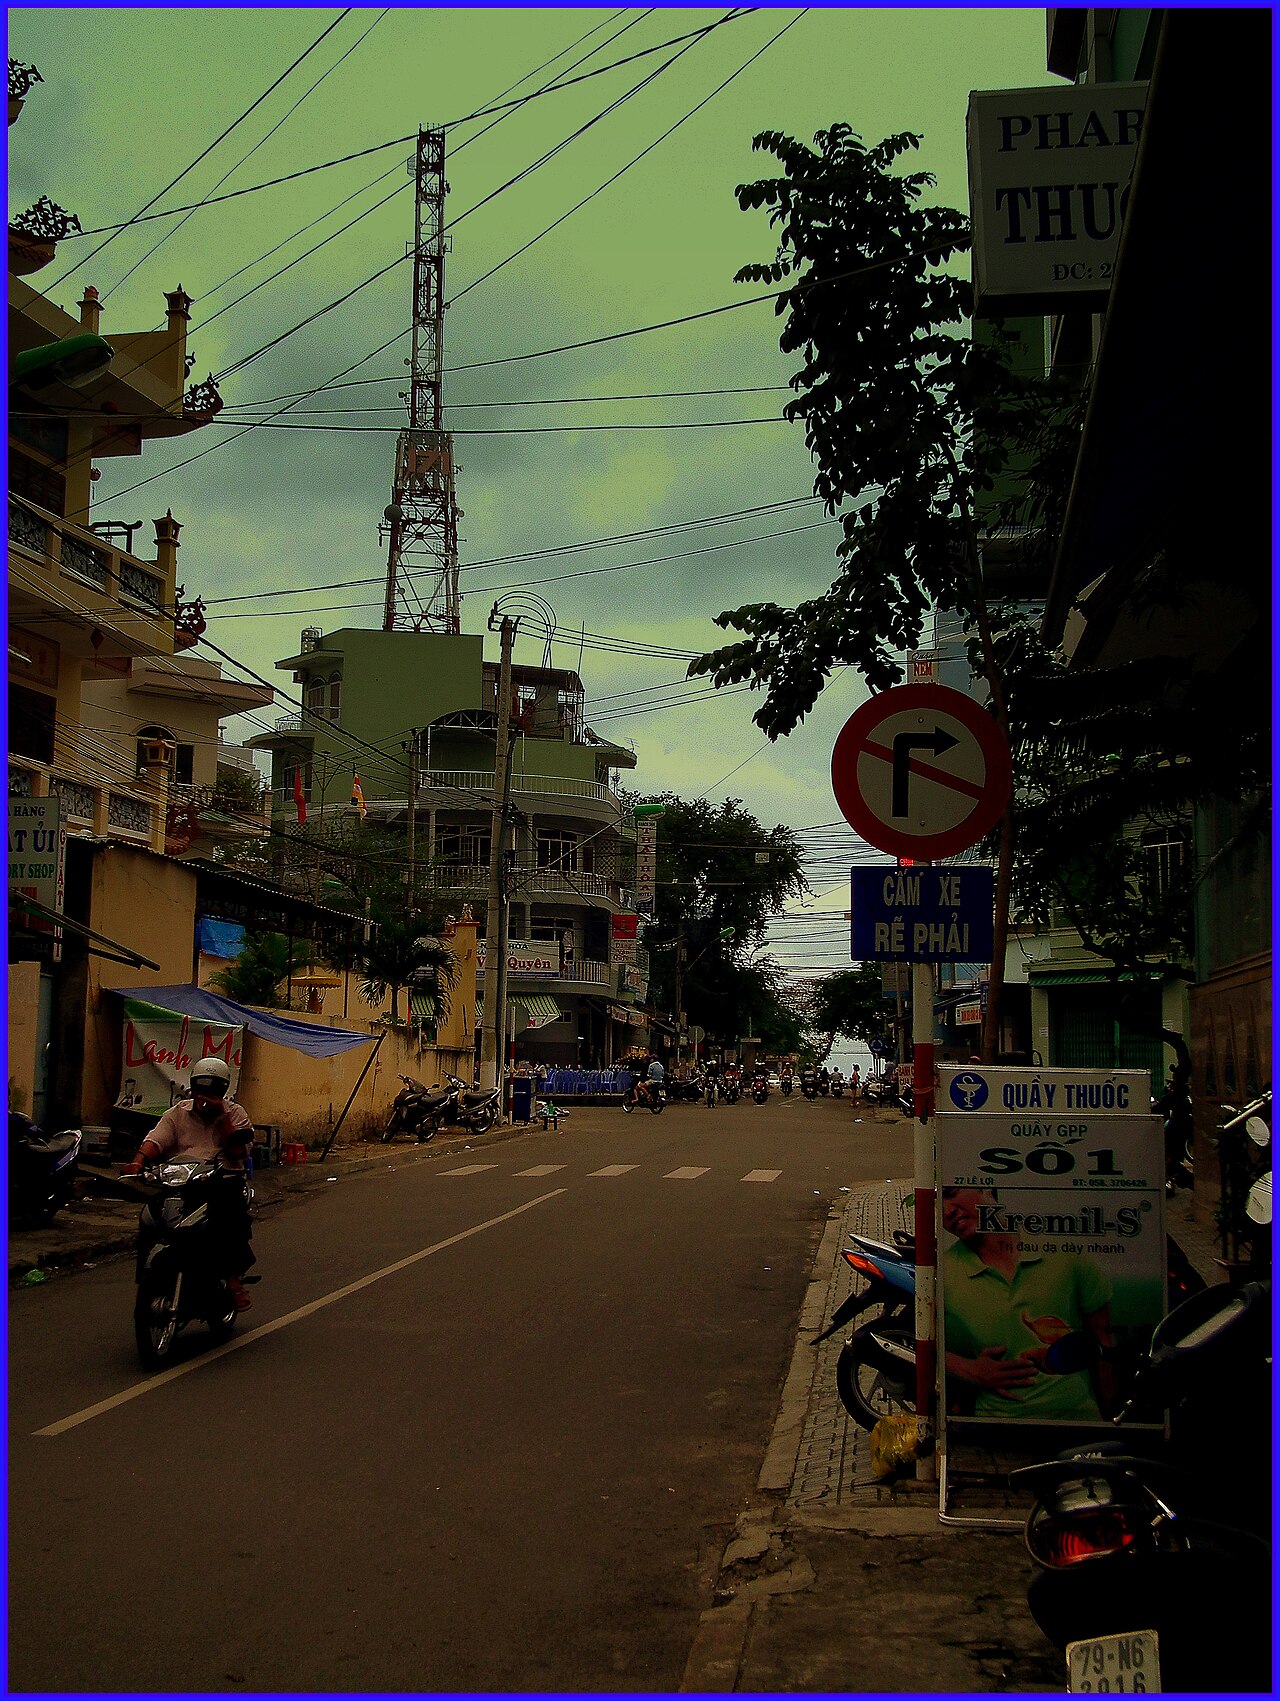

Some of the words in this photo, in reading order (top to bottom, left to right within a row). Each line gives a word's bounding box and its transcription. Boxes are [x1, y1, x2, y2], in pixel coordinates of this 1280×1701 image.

[14, 803, 45, 816] HÀNG
[33, 821, 55, 852] ỦI
[29, 863, 55, 878] SHOP
[882, 870, 920, 907] CẤM
[939, 876, 961, 907] XE
[875, 917, 905, 952] RẼ
[913, 912, 969, 953] PHẢI
[1003, 1075, 1056, 1111] QUẦY
[1064, 1077, 1129, 1109] THUỐC
[1011, 1119, 1052, 1137] QUẦY
[1057, 1124, 1088, 1137] GPP
[977, 1138, 1085, 1175] SỐ
[1087, 1149, 1123, 1175] 1
[954, 1177, 964, 1185] 27
[1016, 1241, 1038, 1252] đau
[1042, 1241, 1057, 1254] dạ
[1061, 1241, 1083, 1255] dày
[1087, 1242, 1125, 1253] nhanh
